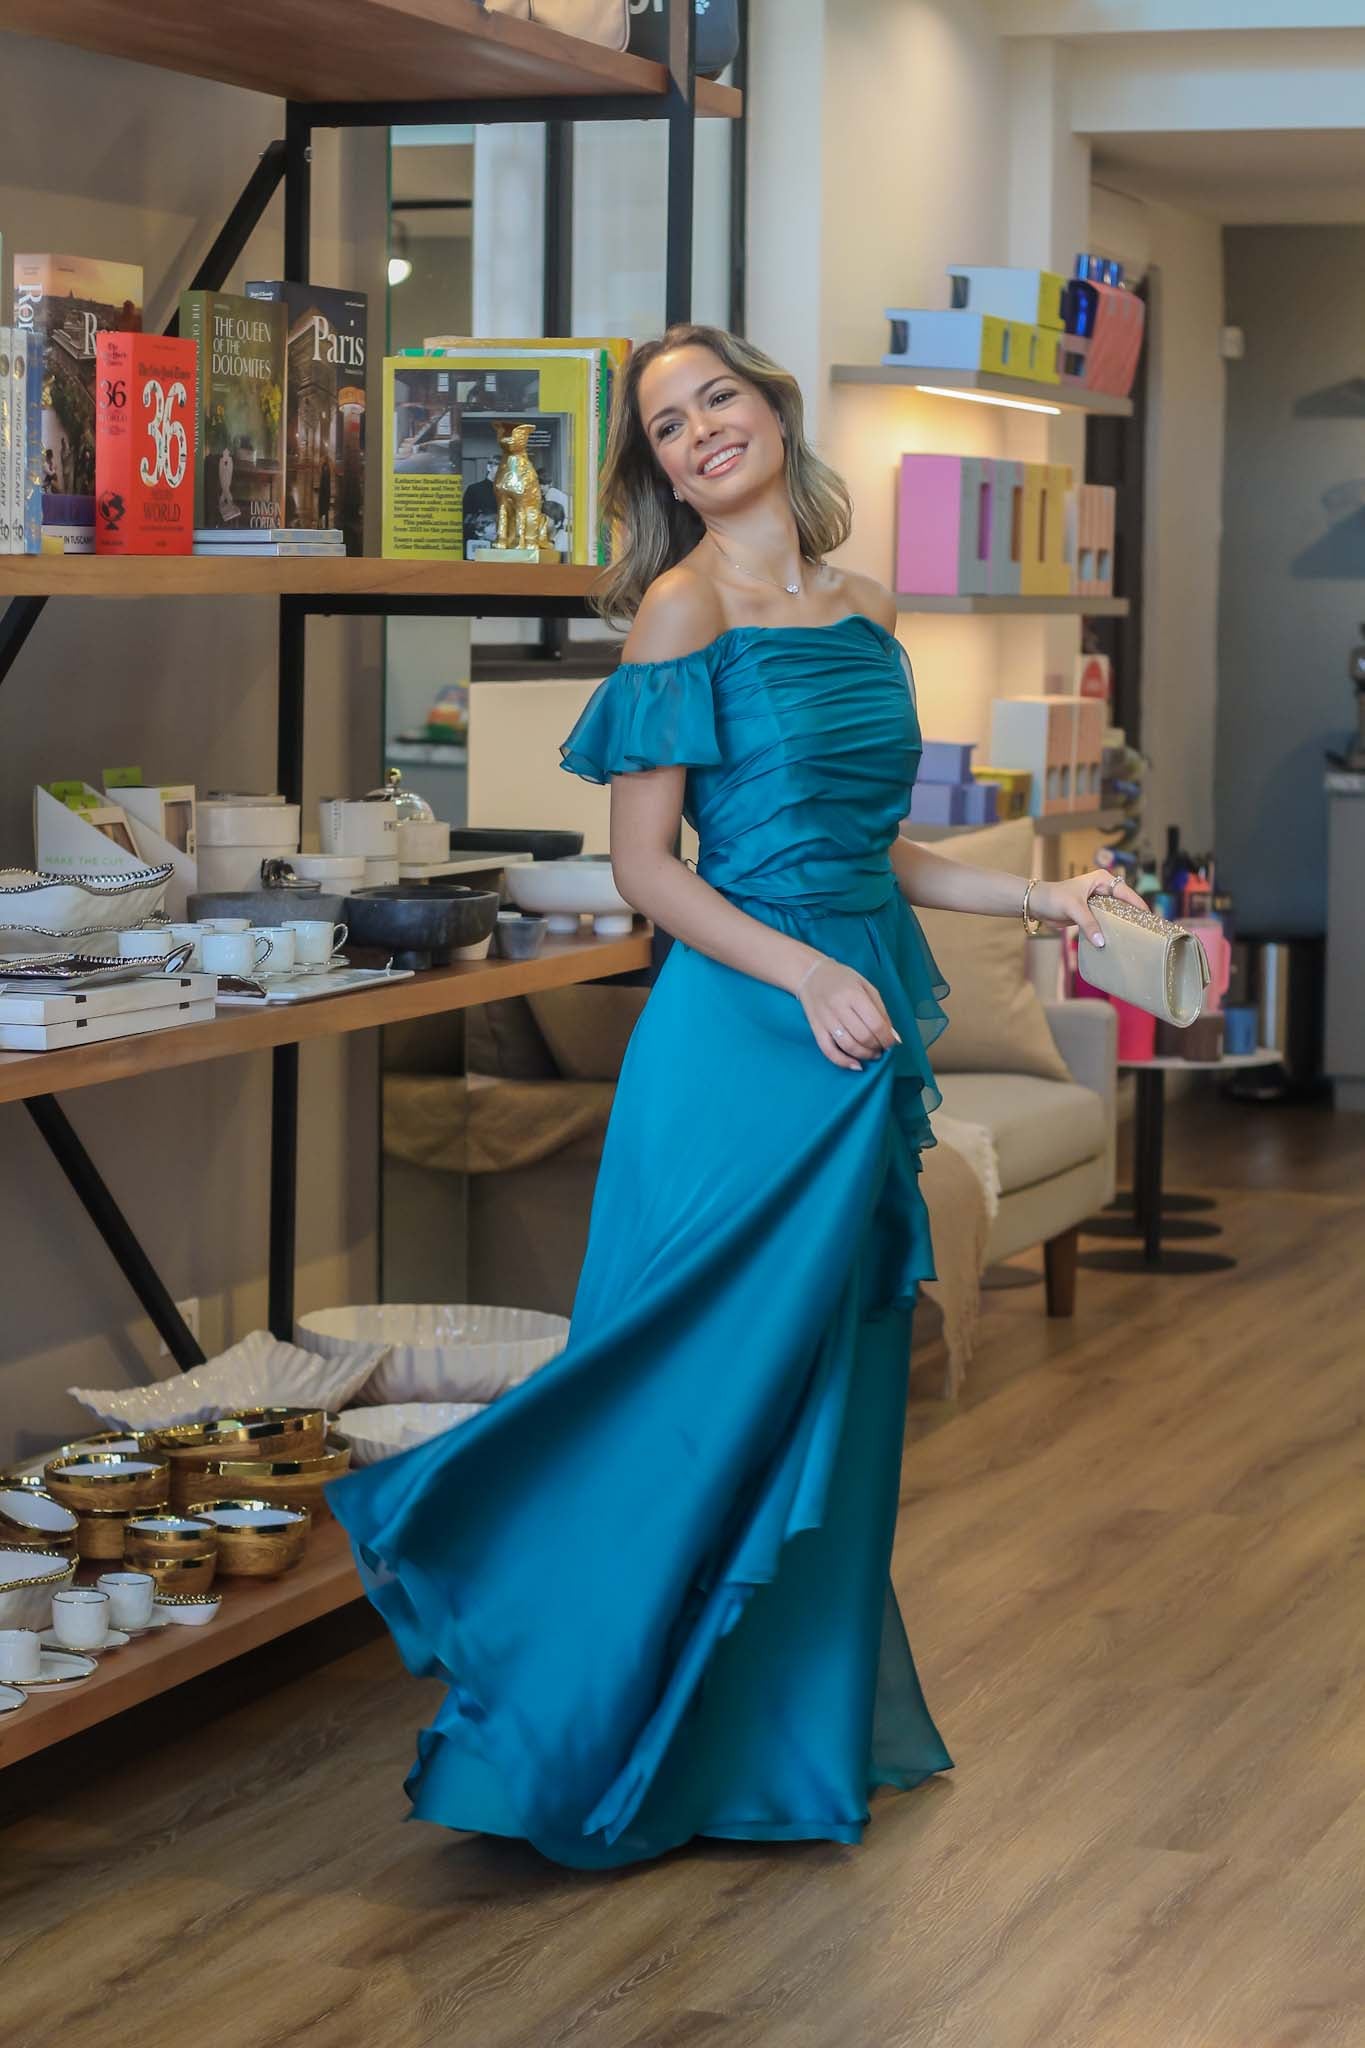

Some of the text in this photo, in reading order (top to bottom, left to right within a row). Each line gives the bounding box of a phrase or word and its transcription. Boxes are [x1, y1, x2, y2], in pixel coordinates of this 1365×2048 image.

[214, 316, 272, 343] THE QUEEN
[312, 315, 365, 366] Paris
[212, 338, 241, 356] OF THE
[212, 353, 272, 380] DOLOMITES
[101, 380, 126, 409] 36
[140, 380, 187, 489] 36
[143, 502, 183, 522] WORLD
